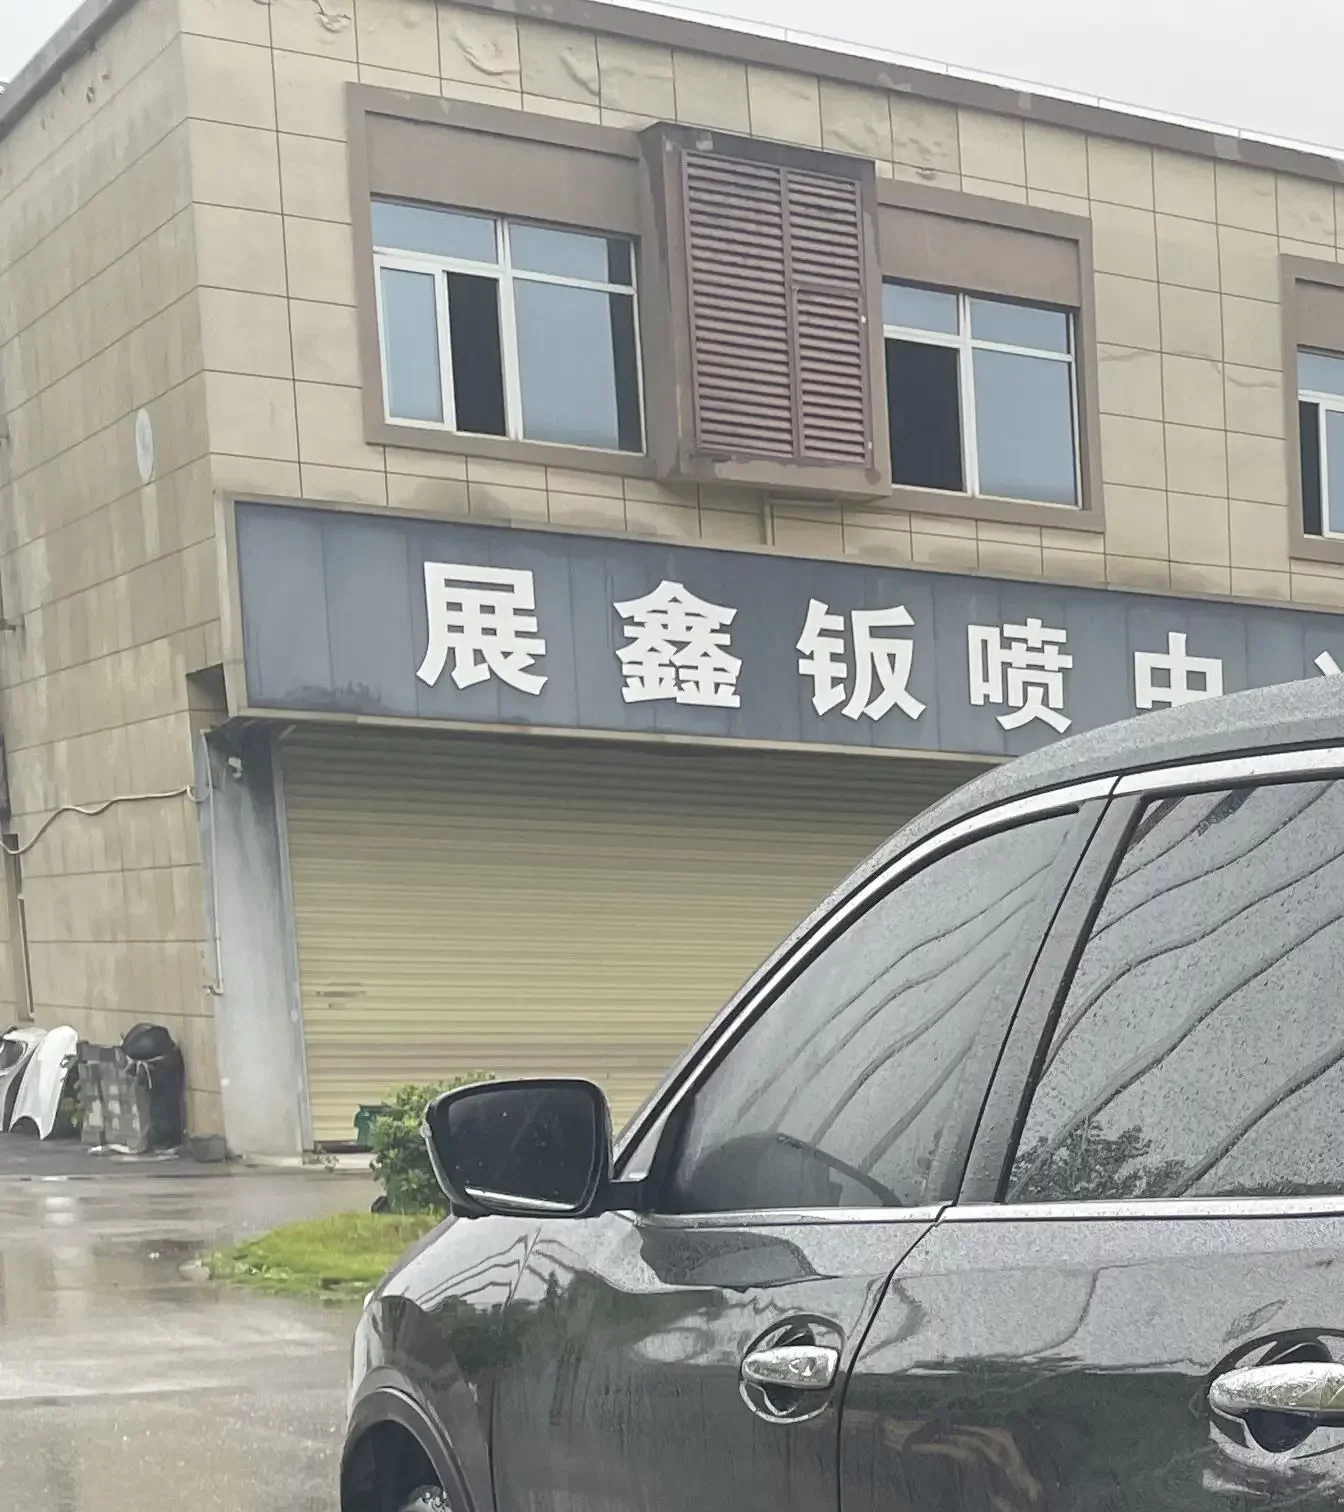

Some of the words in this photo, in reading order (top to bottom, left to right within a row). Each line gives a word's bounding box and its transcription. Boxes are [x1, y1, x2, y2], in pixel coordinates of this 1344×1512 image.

[415, 560, 1342, 734] 展鑫钣喷中
